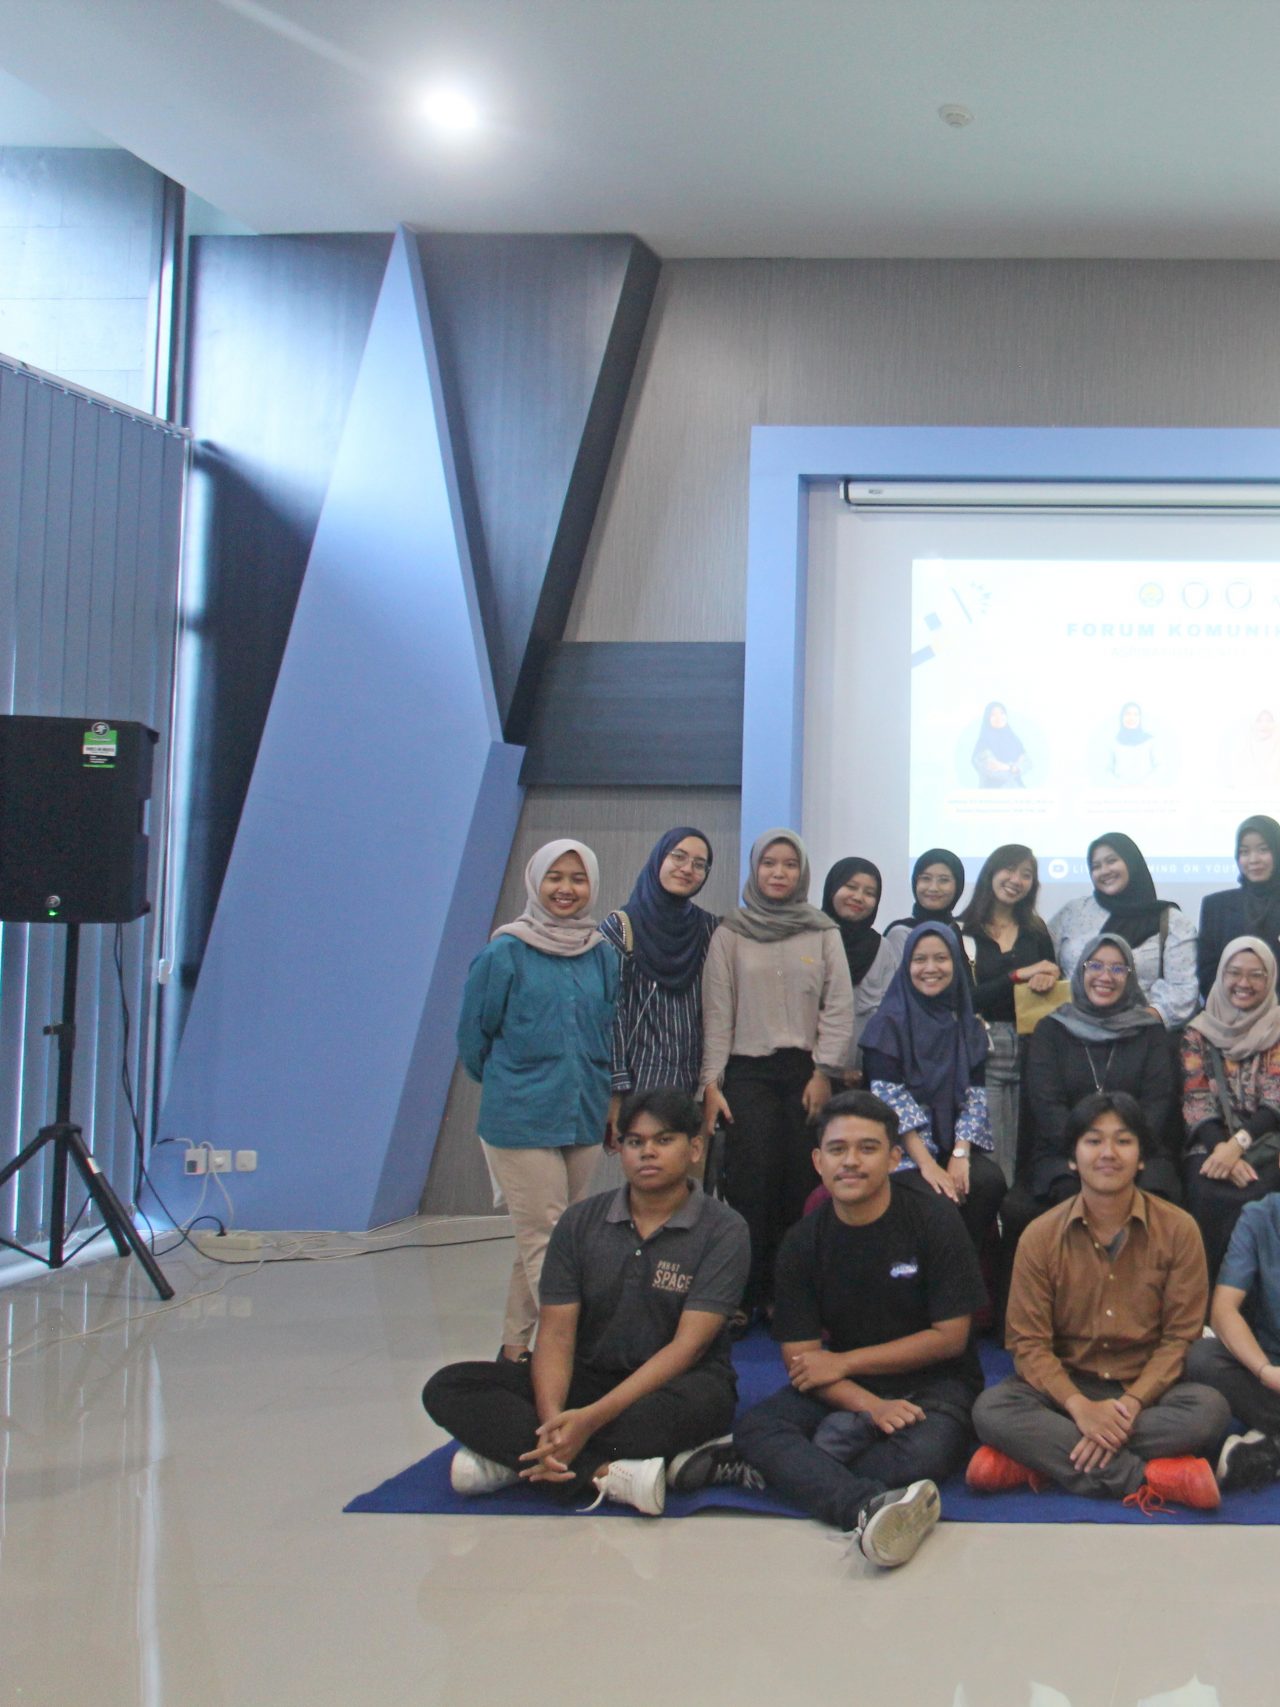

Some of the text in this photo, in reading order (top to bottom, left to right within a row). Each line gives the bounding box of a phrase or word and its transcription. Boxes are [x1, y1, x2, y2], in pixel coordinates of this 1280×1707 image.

[1065, 622, 1155, 638] FORUM
[1183, 863, 1199, 874] ON
[1205, 863, 1238, 874] YOUT
[654, 1269, 693, 1290] SPACE
